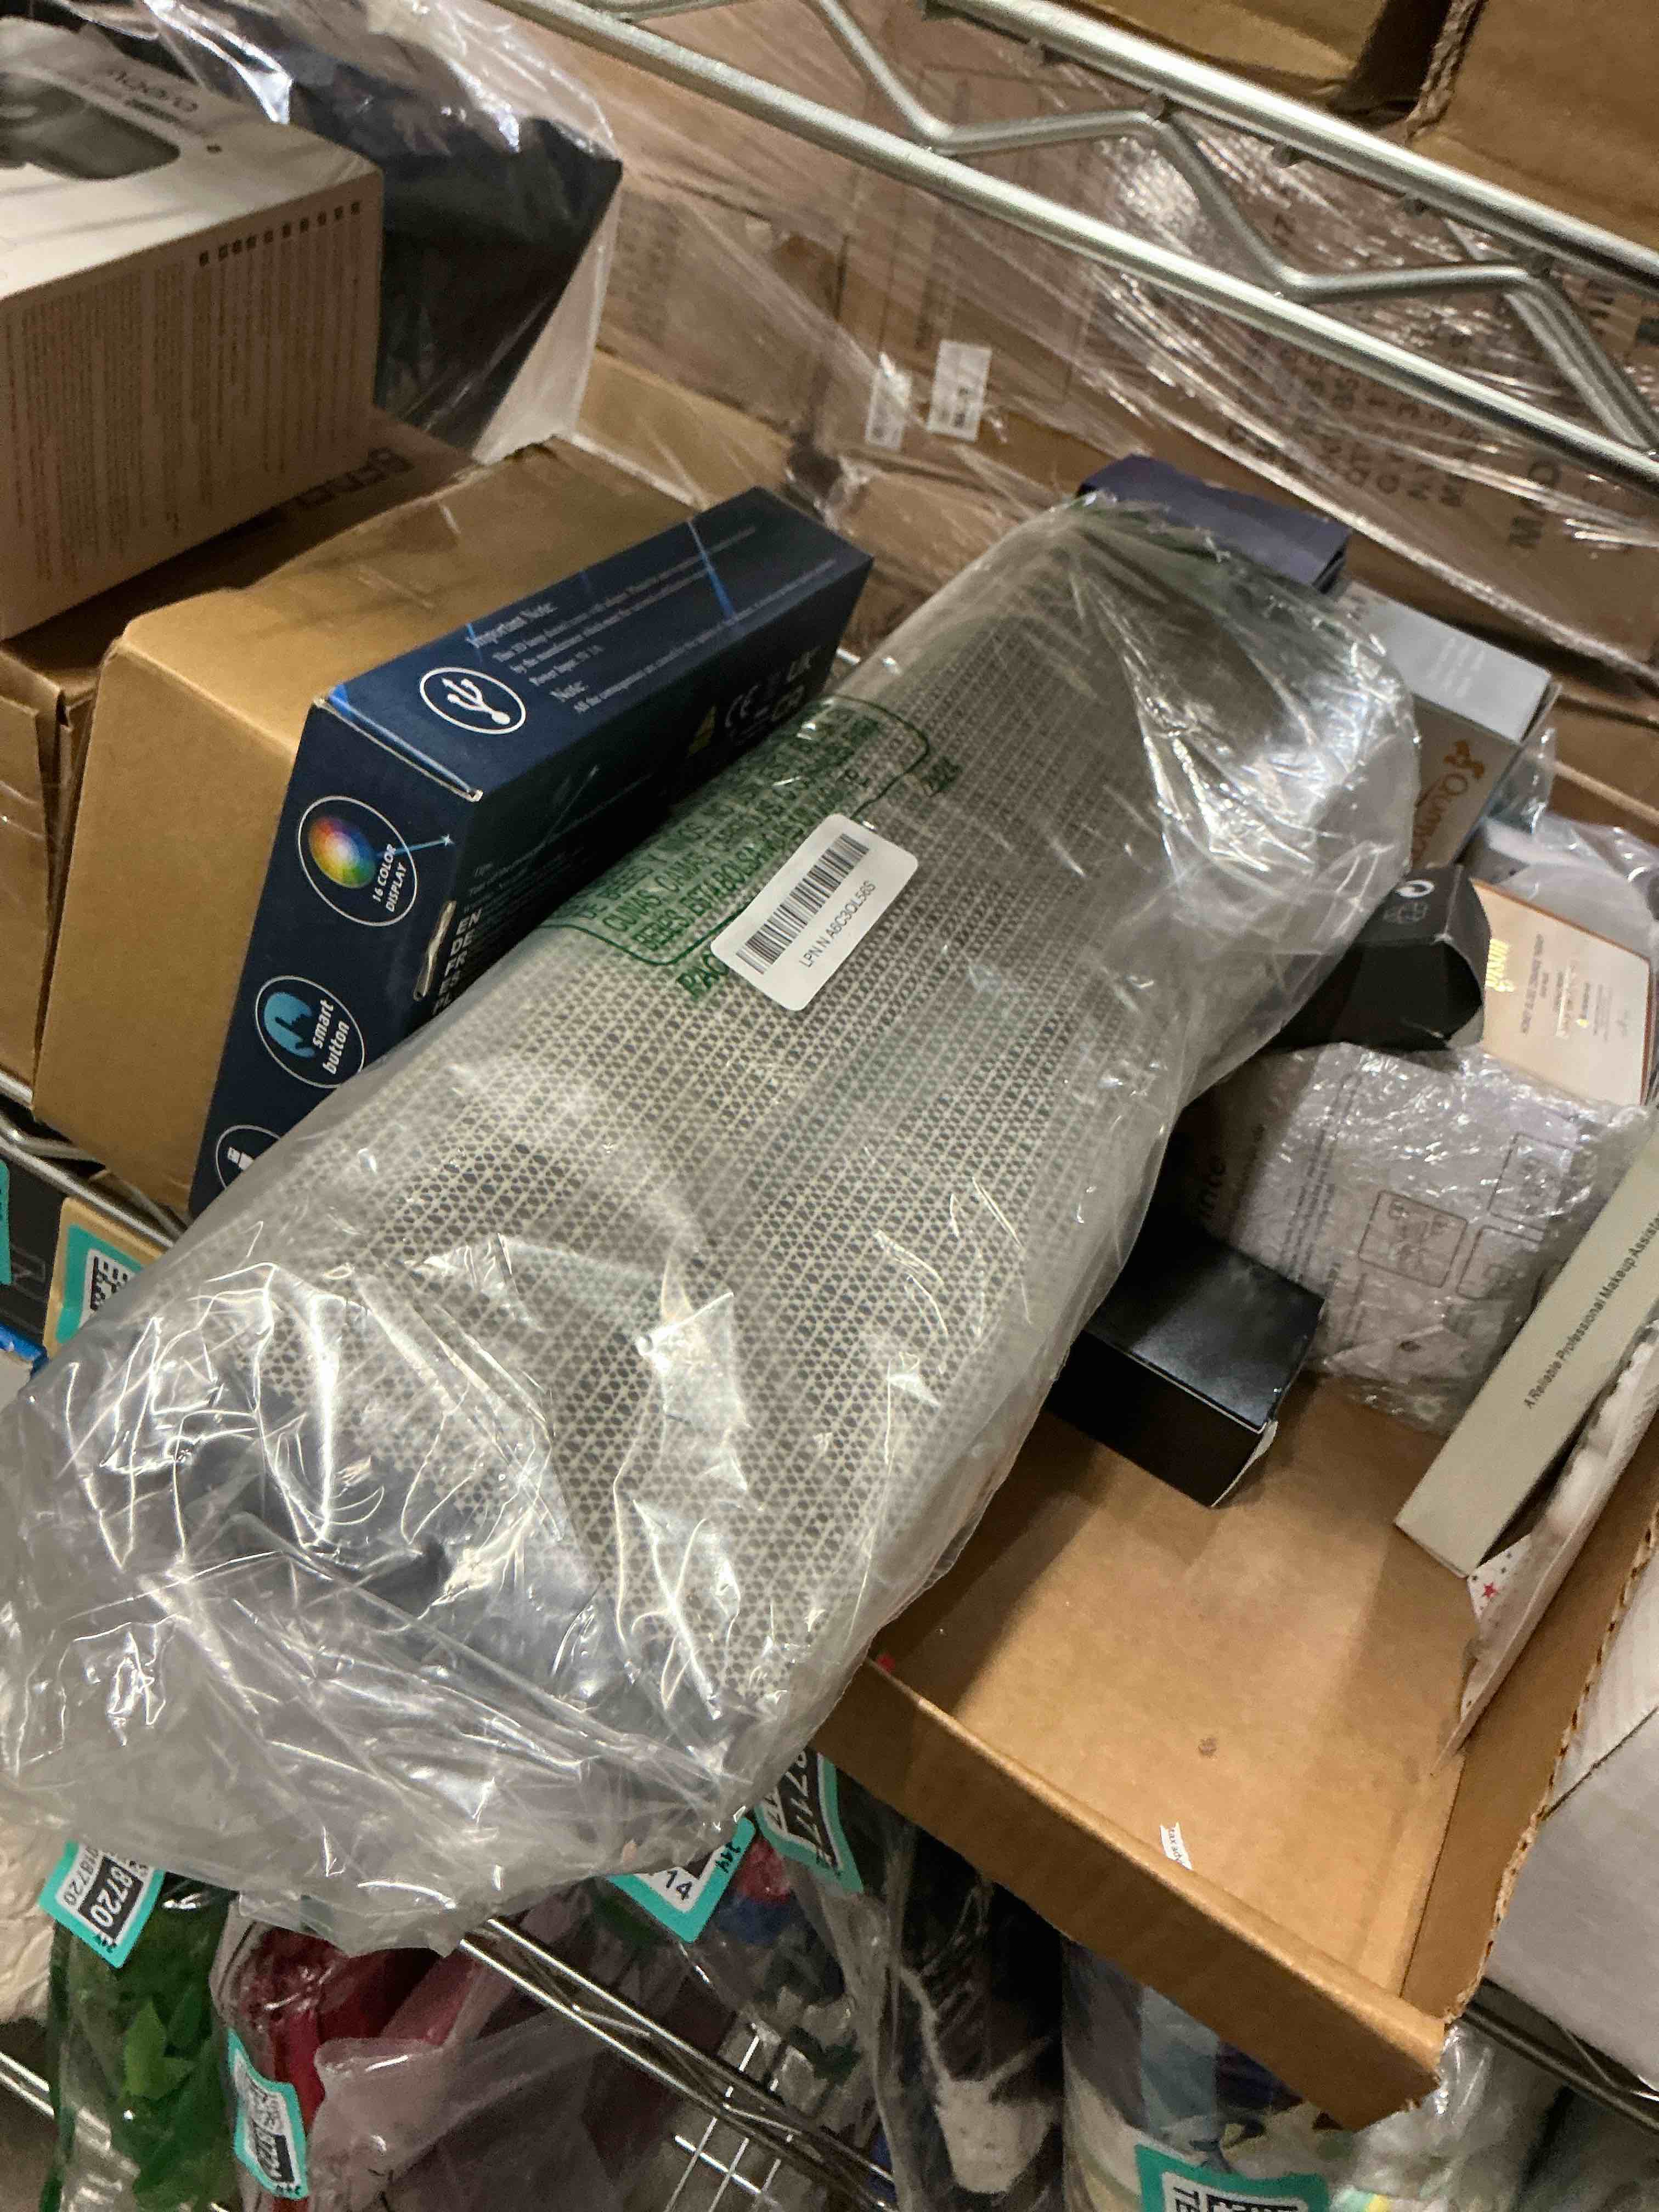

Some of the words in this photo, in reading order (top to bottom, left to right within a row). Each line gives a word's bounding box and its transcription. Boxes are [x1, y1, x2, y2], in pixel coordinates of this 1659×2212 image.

[377, 844, 396, 886] COLOR
[386, 862, 406, 912] DISPLAY
[373, 887, 383, 902] 16
[450, 929, 476, 956] DE
[799, 946, 823, 968] LPN
[313, 1000, 334, 1049] smart
[323, 1020, 349, 1074] button
[1556, 1297, 1606, 1361] Professional
[1599, 1257, 1637, 1300] Makeup
[1628, 1213, 1659, 1259] Assista
[91, 1866, 132, 1927] 8720
